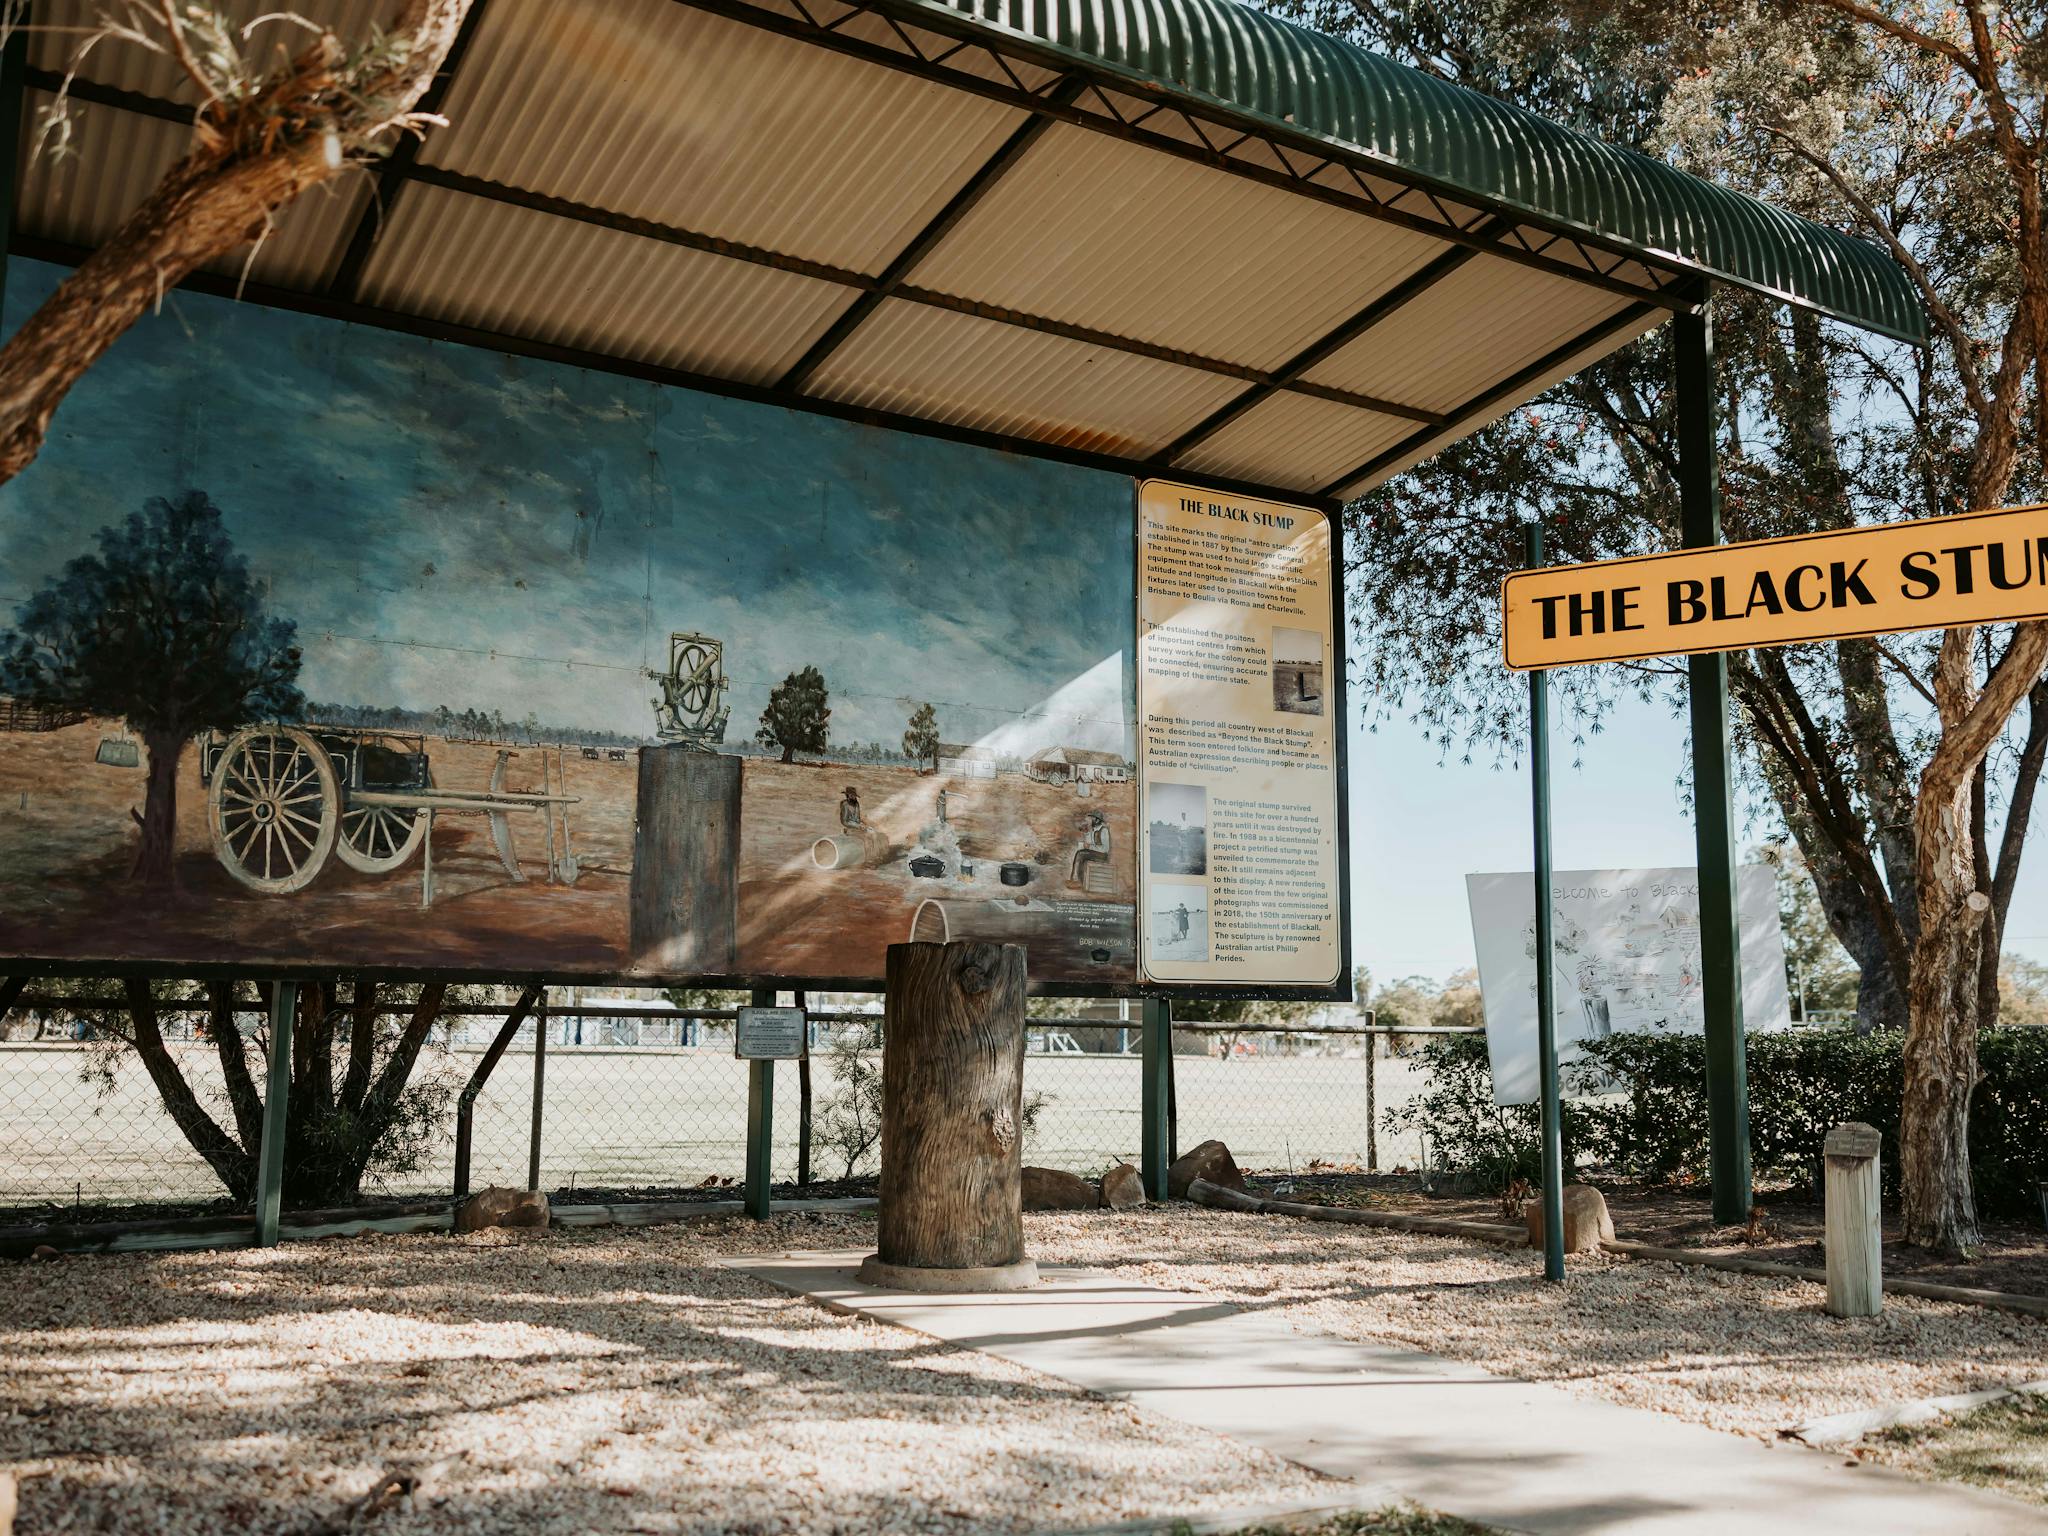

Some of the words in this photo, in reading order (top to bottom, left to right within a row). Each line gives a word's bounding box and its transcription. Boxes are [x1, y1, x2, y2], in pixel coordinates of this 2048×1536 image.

[1180, 498, 1204, 514] THE
[1209, 504, 1249, 522] BLACK
[1253, 512, 1294, 530] STUMP
[1147, 521, 1163, 530] This
[1165, 524, 1179, 533] site
[1181, 527, 1204, 537] marks
[1206, 531, 1218, 539] the
[1219, 533, 1246, 545] original
[1248, 538, 1270, 548] "astro
[1271, 542, 1298, 552] station"
[1147, 532, 1190, 545] established
[1201, 540, 1218, 550] 1887
[1220, 544, 1229, 553] by
[1231, 545, 1243, 553] the
[1244, 547, 1275, 560] Surveyor
[1276, 553, 1305, 563] General.
[1147, 543, 1161, 551] The
[1163, 545, 1186, 557] stump
[1188, 550, 1203, 558] was
[1205, 552, 1223, 561] used
[1233, 556, 1249, 565] hold
[1270, 562, 1302, 573] scientific
[1147, 554, 1186, 567] equipment
[1188, 560, 1203, 569] that
[1205, 562, 1221, 571] took
[1223, 565, 1275, 579] measurements
[1277, 573, 1285, 581] to
[1286, 575, 1317, 586] establish
[1147, 565, 1176, 575] latitude
[1178, 569, 1191, 578] and
[1193, 572, 1227, 584] longitude
[1238, 578, 1266, 589] Blackall
[1268, 583, 1283, 591] with
[1285, 585, 1296, 593] the
[1147, 576, 1176, 586] fixtures
[1178, 580, 1196, 589] later
[1197, 583, 1215, 592] used
[1226, 587, 1255, 599] position
[1256, 591, 1278, 601] towns
[1279, 595, 1295, 603] from
[1532, 586, 1644, 640] THE
[1667, 558, 1877, 626] BLACK
[1900, 537, 2048, 600] STU
[1147, 586, 1180, 598] Brisbane
[1182, 591, 1190, 599] to
[1192, 593, 1215, 602] Boulia
[1217, 596, 1228, 604] via
[1230, 598, 1250, 607] Roma
[1251, 601, 1265, 609] and
[1266, 603, 1305, 615] Charleville.
[1147, 623, 1164, 631] This
[1165, 625, 1209, 637] established
[1210, 631, 1223, 639] the
[1147, 633, 1155, 641] of
[1157, 635, 1194, 647] important
[1196, 640, 1224, 650] centres
[1225, 643, 1242, 652] from
[1244, 646, 1265, 655] which
[1147, 646, 1173, 656] survey
[1174, 648, 1193, 657] work
[1207, 652, 1219, 660] the
[1221, 654, 1245, 665] colony
[1247, 657, 1266, 666] could
[1158, 657, 1200, 669] connected,
[1201, 662, 1234, 674] ensuring
[1235, 666, 1267, 676] accurate
[1147, 667, 1180, 678] mapping
[1191, 672, 1204, 680] the
[1205, 673, 1227, 682] entire
[1229, 676, 1250, 685] state.
[1148, 714, 1173, 725] During
[1175, 717, 1189, 725] this
[1191, 719, 1215, 729] period
[1216, 721, 1226, 729] all
[1227, 722, 1255, 733] country
[1257, 725, 1274, 733] west
[1285, 728, 1313, 737] Blackall
[1168, 727, 1205, 738] described
[1217, 732, 1248, 743] "Beyond
[1249, 735, 1261, 743] the
[1263, 737, 1283, 745] Black
[1285, 739, 1312, 749] Stump".
[1148, 736, 1165, 745] This
[1167, 738, 1185, 747] term
[1207, 742, 1235, 751] entered
[1237, 745, 1264, 754] folklore
[1266, 747, 1279, 755] and
[1281, 749, 1308, 758] became
[1148, 748, 1187, 758] Australian
[1189, 751, 1230, 763] expression
[1271, 759, 1294, 769] people
[1305, 762, 1328, 771] places
[1148, 759, 1177, 768] outside
[1179, 761, 1187, 769] of
[1281, 803, 1311, 812] survived
[1290, 814, 1318, 823] hundred
[1213, 831, 1228, 839] fire.
[1276, 824, 1311, 834] destroyed
[1213, 842, 1239, 852] project
[1247, 844, 1278, 854] petrified
[1213, 853, 1243, 862] unveiled
[1254, 855, 1305, 865] commemorate
[1213, 864, 1229, 872] site.
[1254, 888, 1271, 896] from
[1291, 879, 1325, 889] rendering
[1213, 898, 1259, 908] photographs
[1277, 900, 1328, 909] commissioned
[1223, 909, 1243, 918] 2018,
[1280, 911, 1322, 921] anniversary
[1228, 921, 1279, 929] establishment
[1079, 937, 1093, 946] BOB
[1096, 938, 1123, 948] WILSON
[1230, 932, 1265, 941] sculpture
[1275, 933, 1284, 942] by
[1214, 943, 1252, 951] Australian
[1275, 944, 1298, 953] Phillip
[1215, 954, 1244, 962] Perides.
